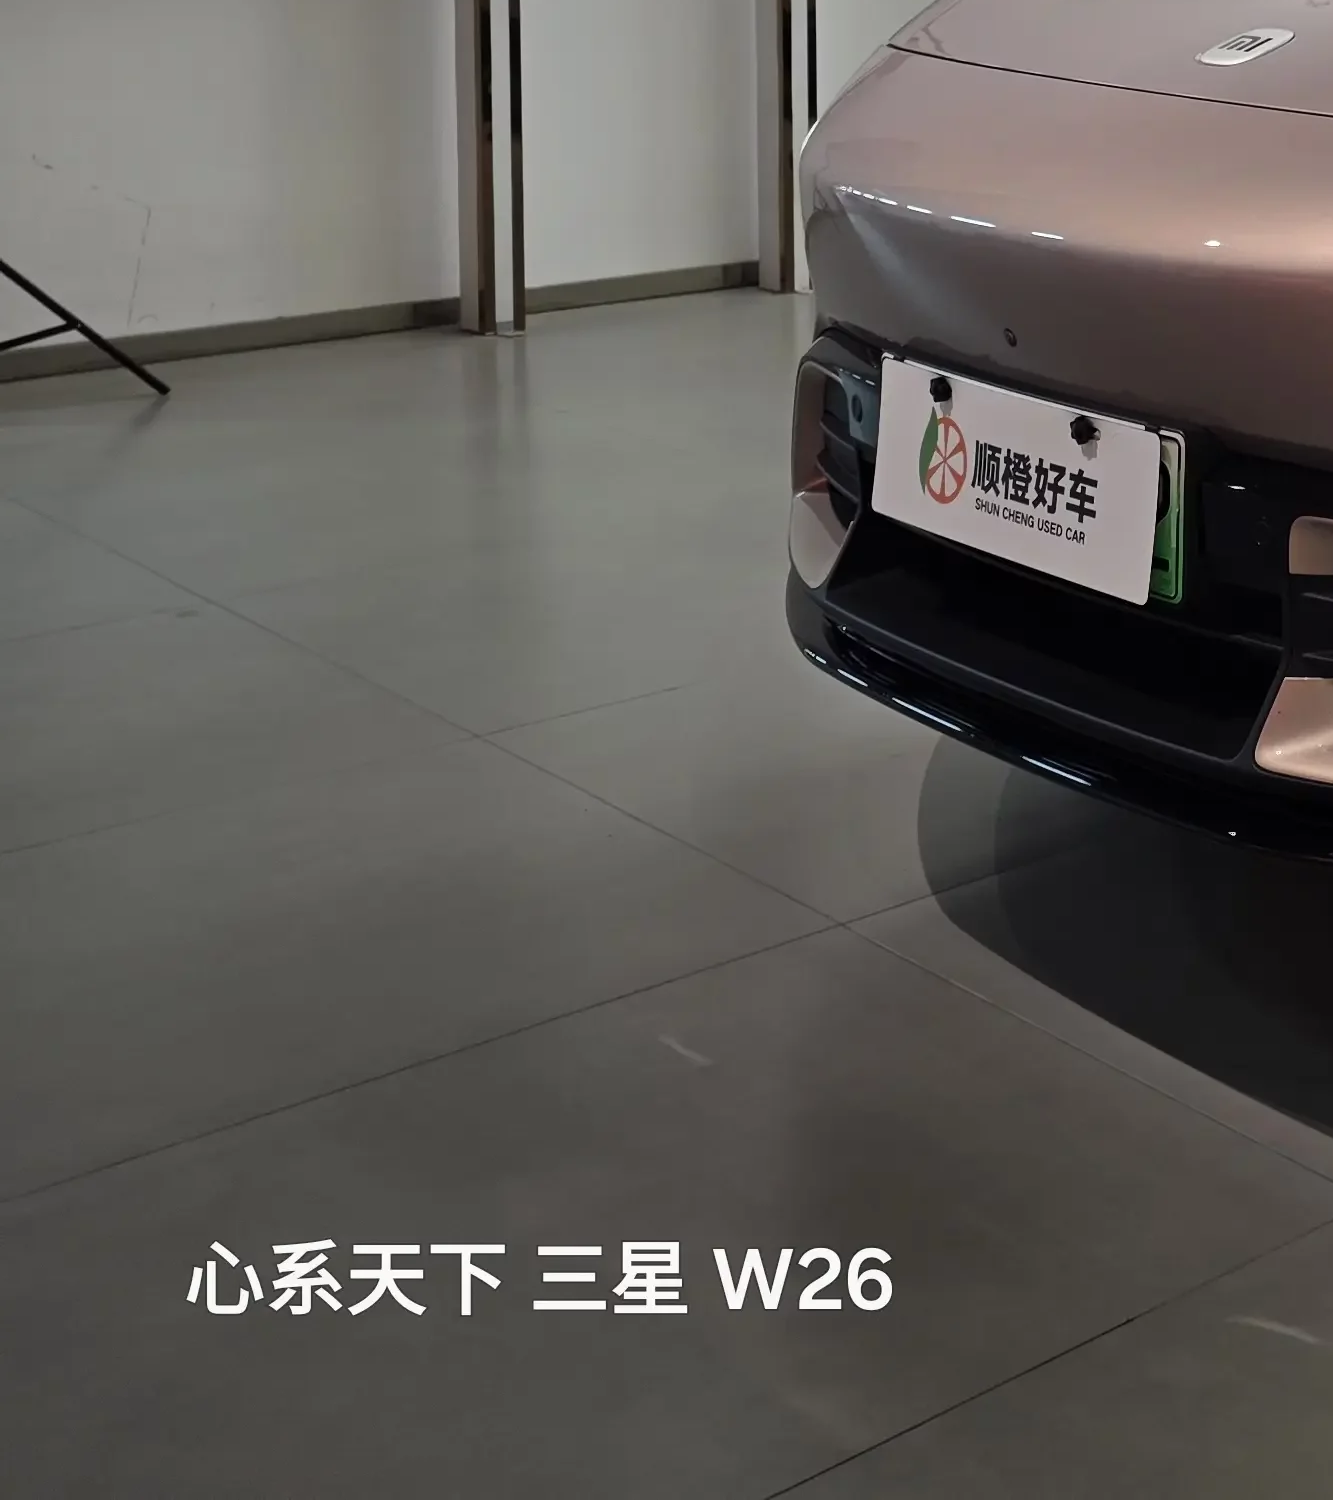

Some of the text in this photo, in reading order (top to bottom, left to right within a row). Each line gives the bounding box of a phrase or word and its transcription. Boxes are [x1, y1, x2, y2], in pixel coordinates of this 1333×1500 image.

[970, 439, 1099, 524] 顺橙好车
[974, 497, 1086, 545] SHUN CHENG USED CAR
